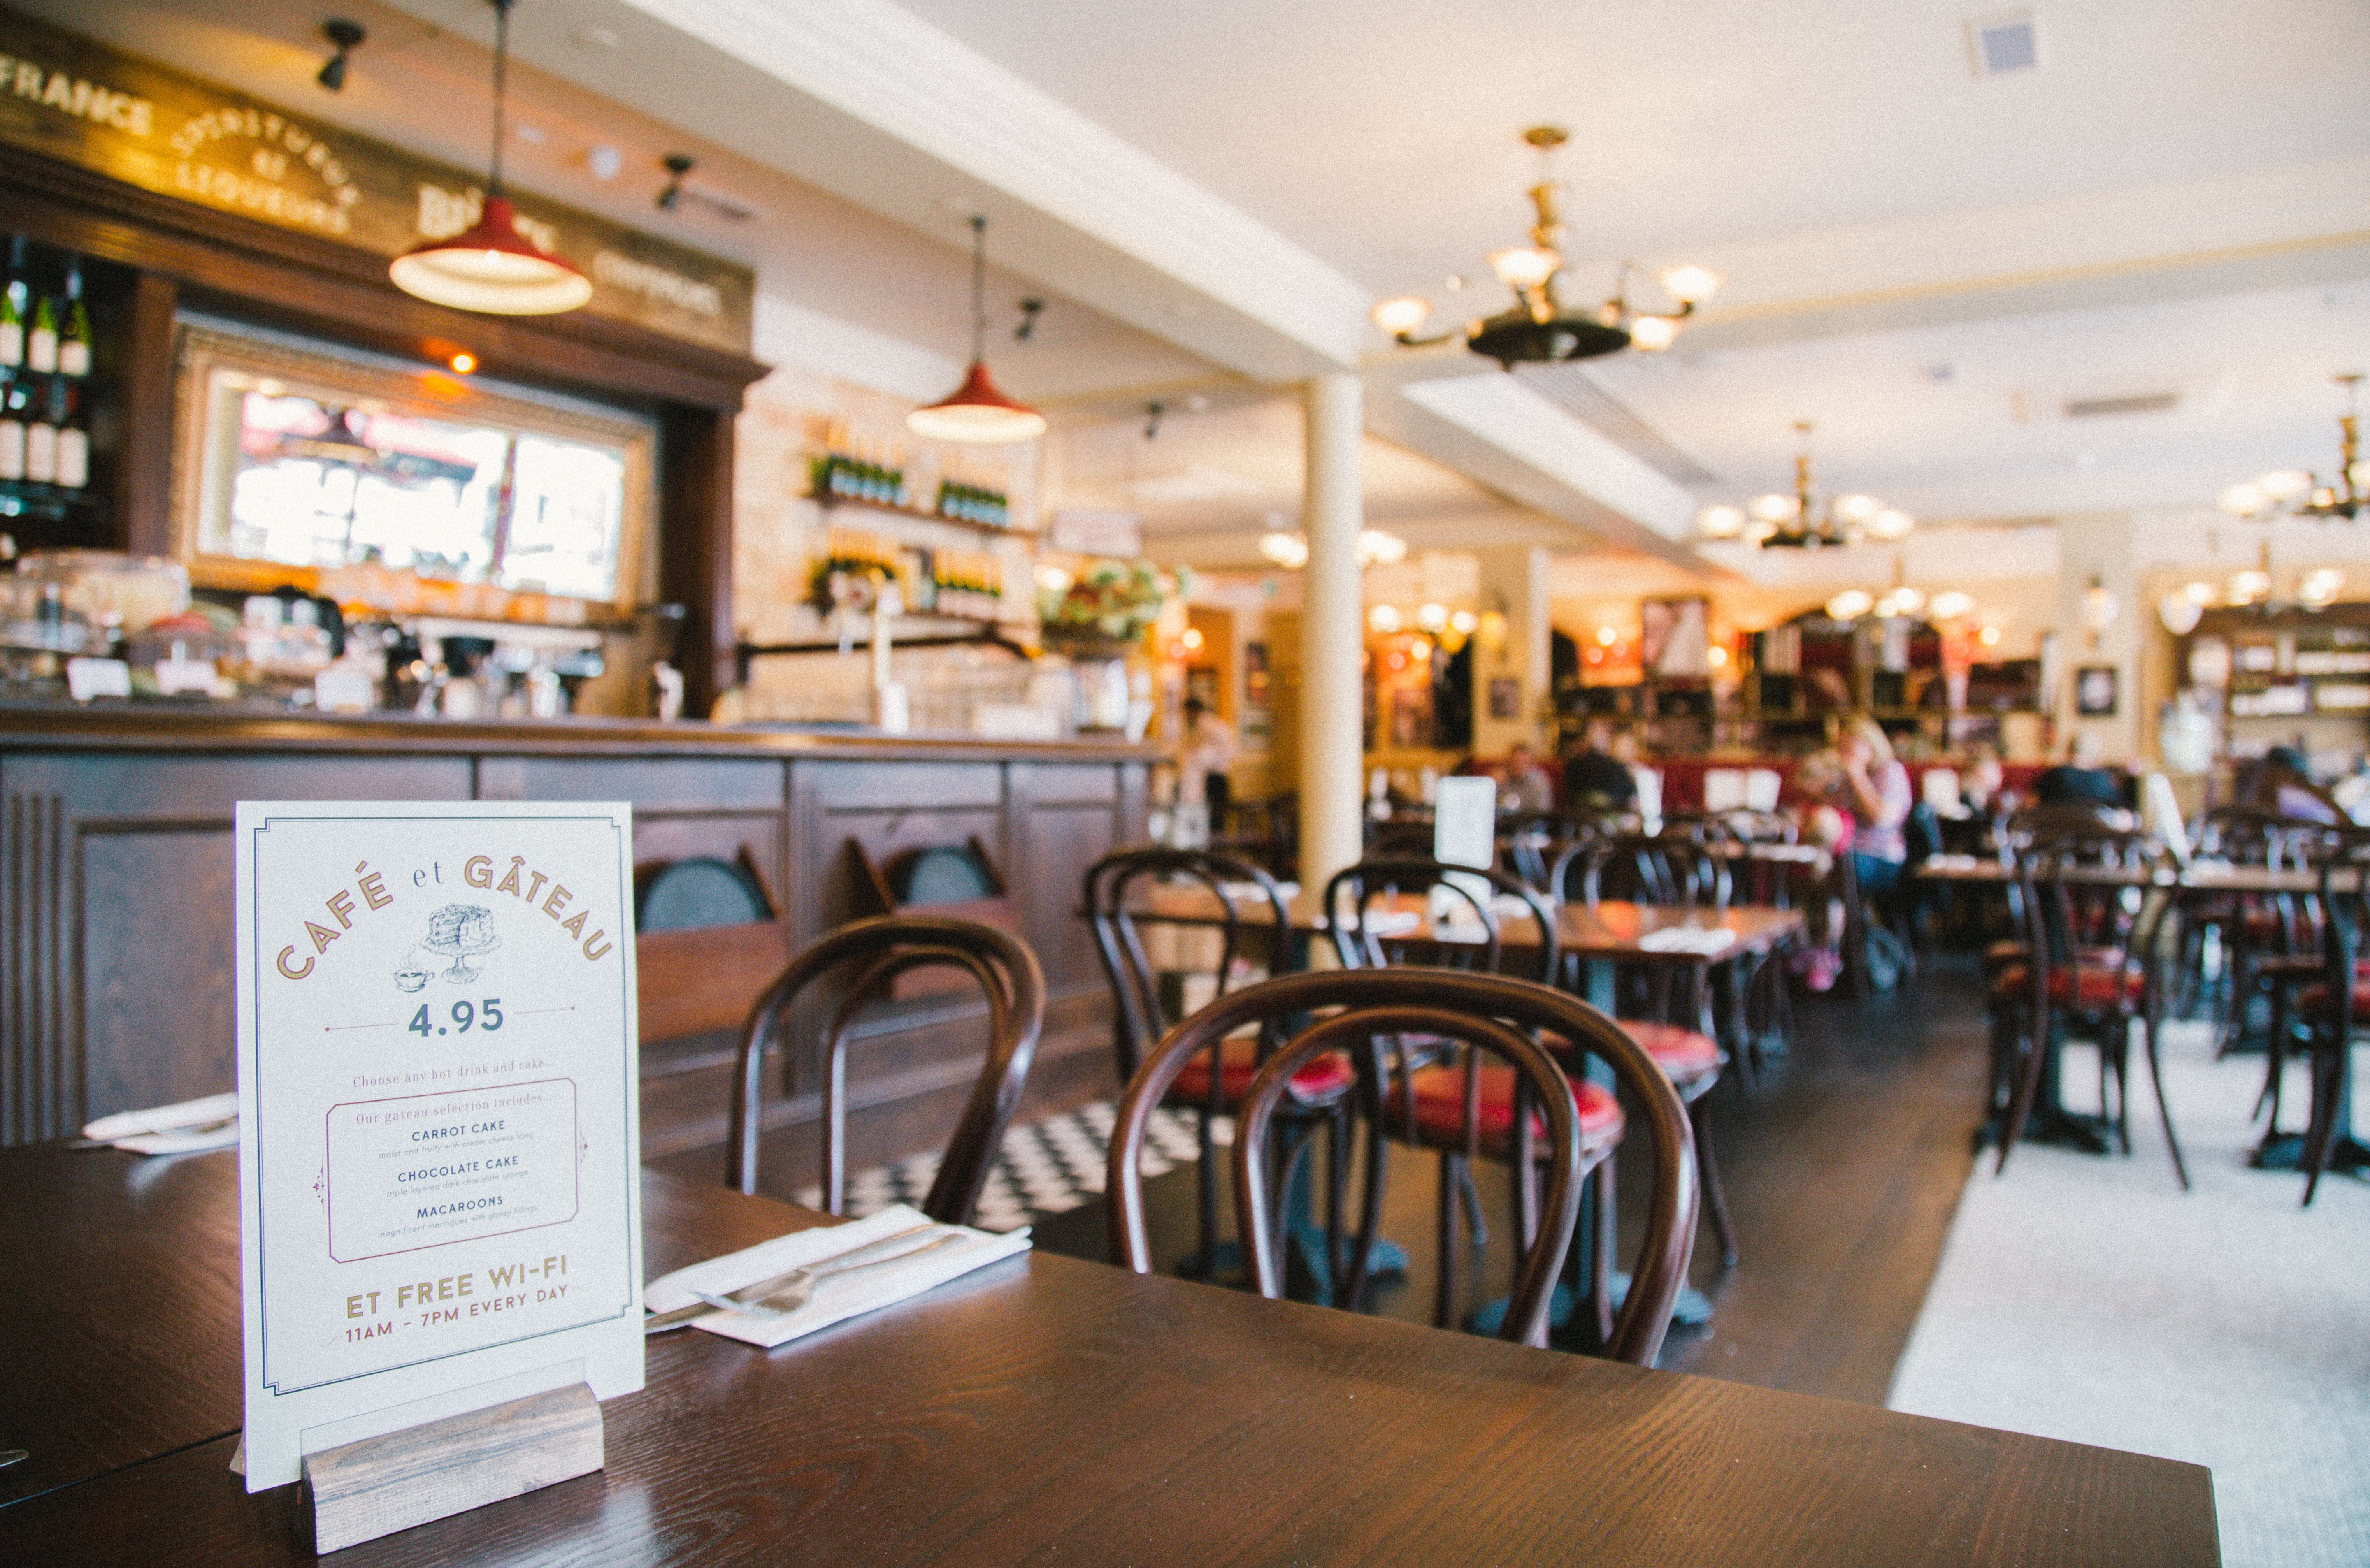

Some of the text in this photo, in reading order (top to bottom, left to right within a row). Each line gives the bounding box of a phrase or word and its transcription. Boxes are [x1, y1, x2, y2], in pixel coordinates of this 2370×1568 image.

[276, 855, 612, 980] CAFÉ et GÂTEAU
[407, 998, 504, 1038] 4.95
[353, 1075, 399, 1088] Choose
[404, 1072, 426, 1084] any
[431, 1069, 451, 1080] hot
[457, 1064, 489, 1076] drink
[493, 1061, 514, 1072] and
[356, 1113, 379, 1125] Our
[384, 1109, 428, 1125] gateau
[433, 1100, 489, 1116] selection
[411, 1120, 505, 1141] CARROT CAKE
[379, 1131, 534, 1159] moist and fruity with cream cheese icing
[397, 1155, 518, 1183] CHOCOLATE CAKE
[386, 1170, 528, 1198] triple layered dark chocolate sponge
[416, 1195, 503, 1219] MACAROONS
[378, 1225, 425, 1238] magnificent
[428, 1218, 467, 1229] meringues
[471, 1213, 486, 1222] with
[346, 1255, 567, 1319] ET FREE WI-FI
[345, 1320, 393, 1343] 11AM
[421, 1307, 460, 1327] 7PM
[469, 1293, 527, 1317] EVERY
[537, 1284, 567, 1302] DAY
